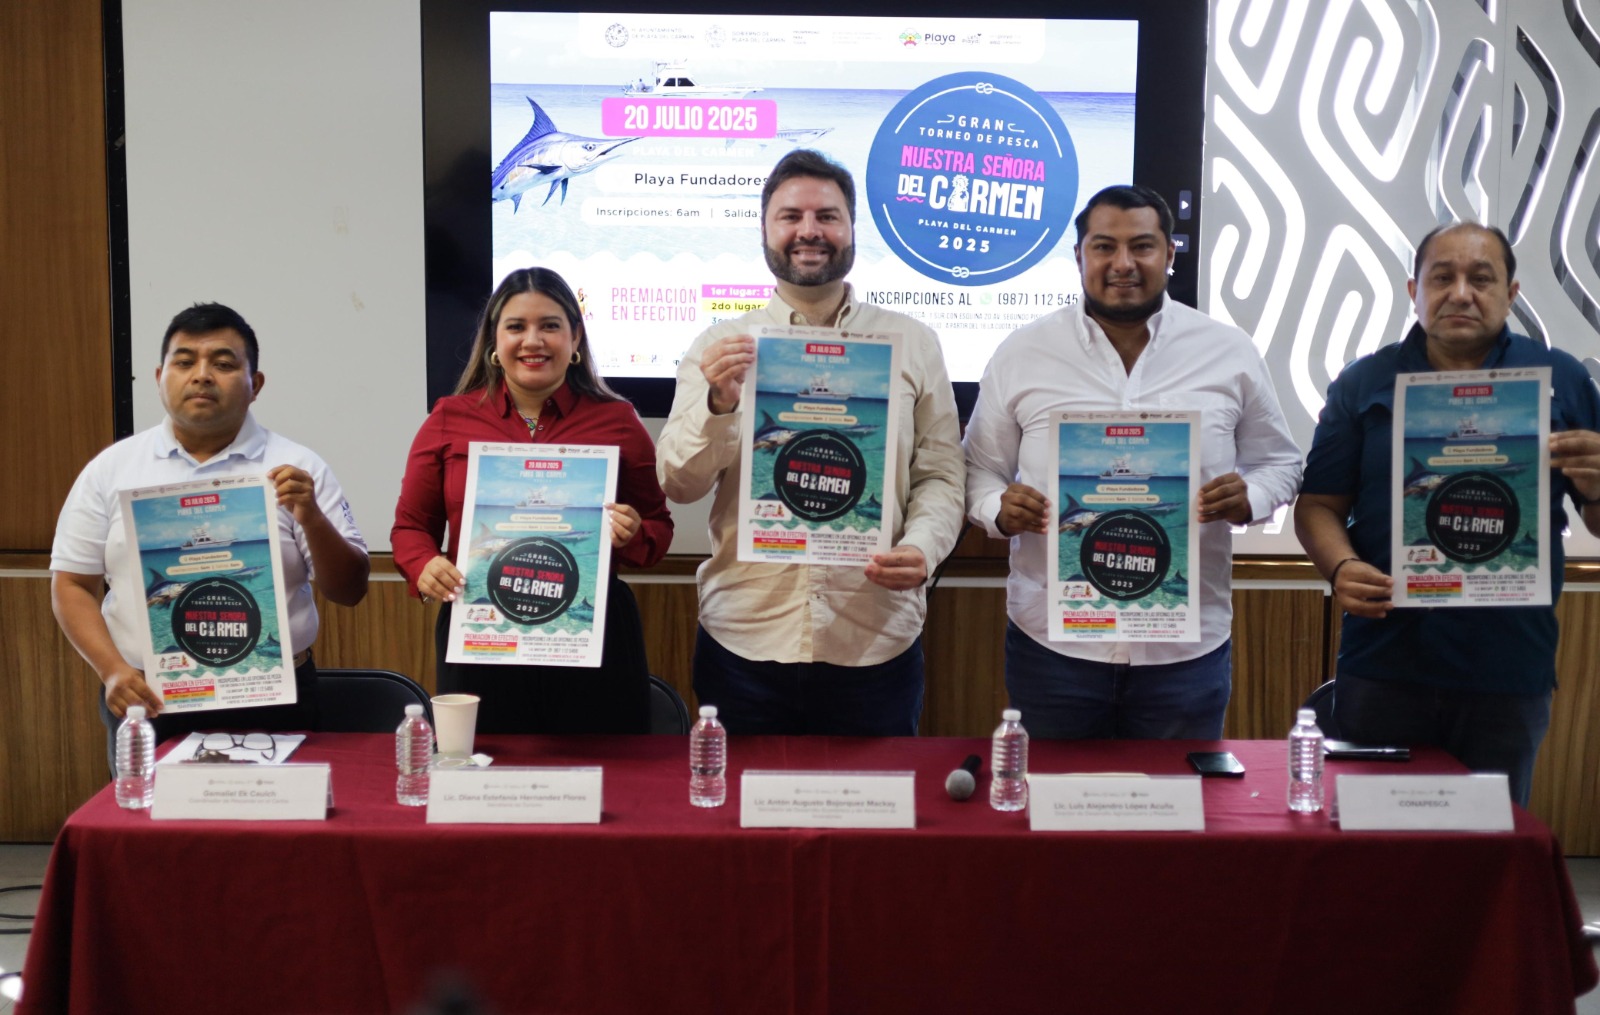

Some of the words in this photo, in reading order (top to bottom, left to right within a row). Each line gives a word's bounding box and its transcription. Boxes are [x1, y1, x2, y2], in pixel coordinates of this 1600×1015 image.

[925, 32, 956, 46] Playa
[624, 105, 648, 130] 20
[653, 106, 703, 130] JULIO
[708, 107, 757, 131] 2025
[958, 115, 1004, 131] GRAN
[919, 126, 971, 141] TORNEO
[977, 134, 992, 144] DE
[998, 136, 1039, 148] PESCA
[901, 145, 975, 173] NUESTRA
[982, 154, 1045, 181] SEÑORA
[635, 173, 674, 187] Playa
[680, 174, 768, 186] Fundadores
[898, 174, 926, 197] DEL
[596, 208, 673, 218] Inscripciones:
[676, 208, 700, 217] 6am
[919, 219, 949, 228] PLAYA
[976, 225, 1017, 236] CARMEN
[939, 235, 990, 252] 2025
[612, 286, 697, 303] PREMIACIÓN
[711, 287, 725, 296] 1er
[729, 287, 760, 298] lugar:
[867, 292, 954, 305] INSCRIPCIONES
[959, 293, 972, 305] AL
[998, 293, 1028, 306] (987)
[1034, 294, 1053, 306] 112
[612, 305, 628, 320] EN
[634, 306, 696, 321] EFECTIVO
[786, 472, 799, 483] DEL
[804, 500, 826, 510] 2025
[1093, 553, 1105, 563] DEL
[500, 576, 512, 588] DEL
[1111, 580, 1133, 588] 2025
[516, 604, 539, 613] 2025
[185, 623, 197, 632] DEL
